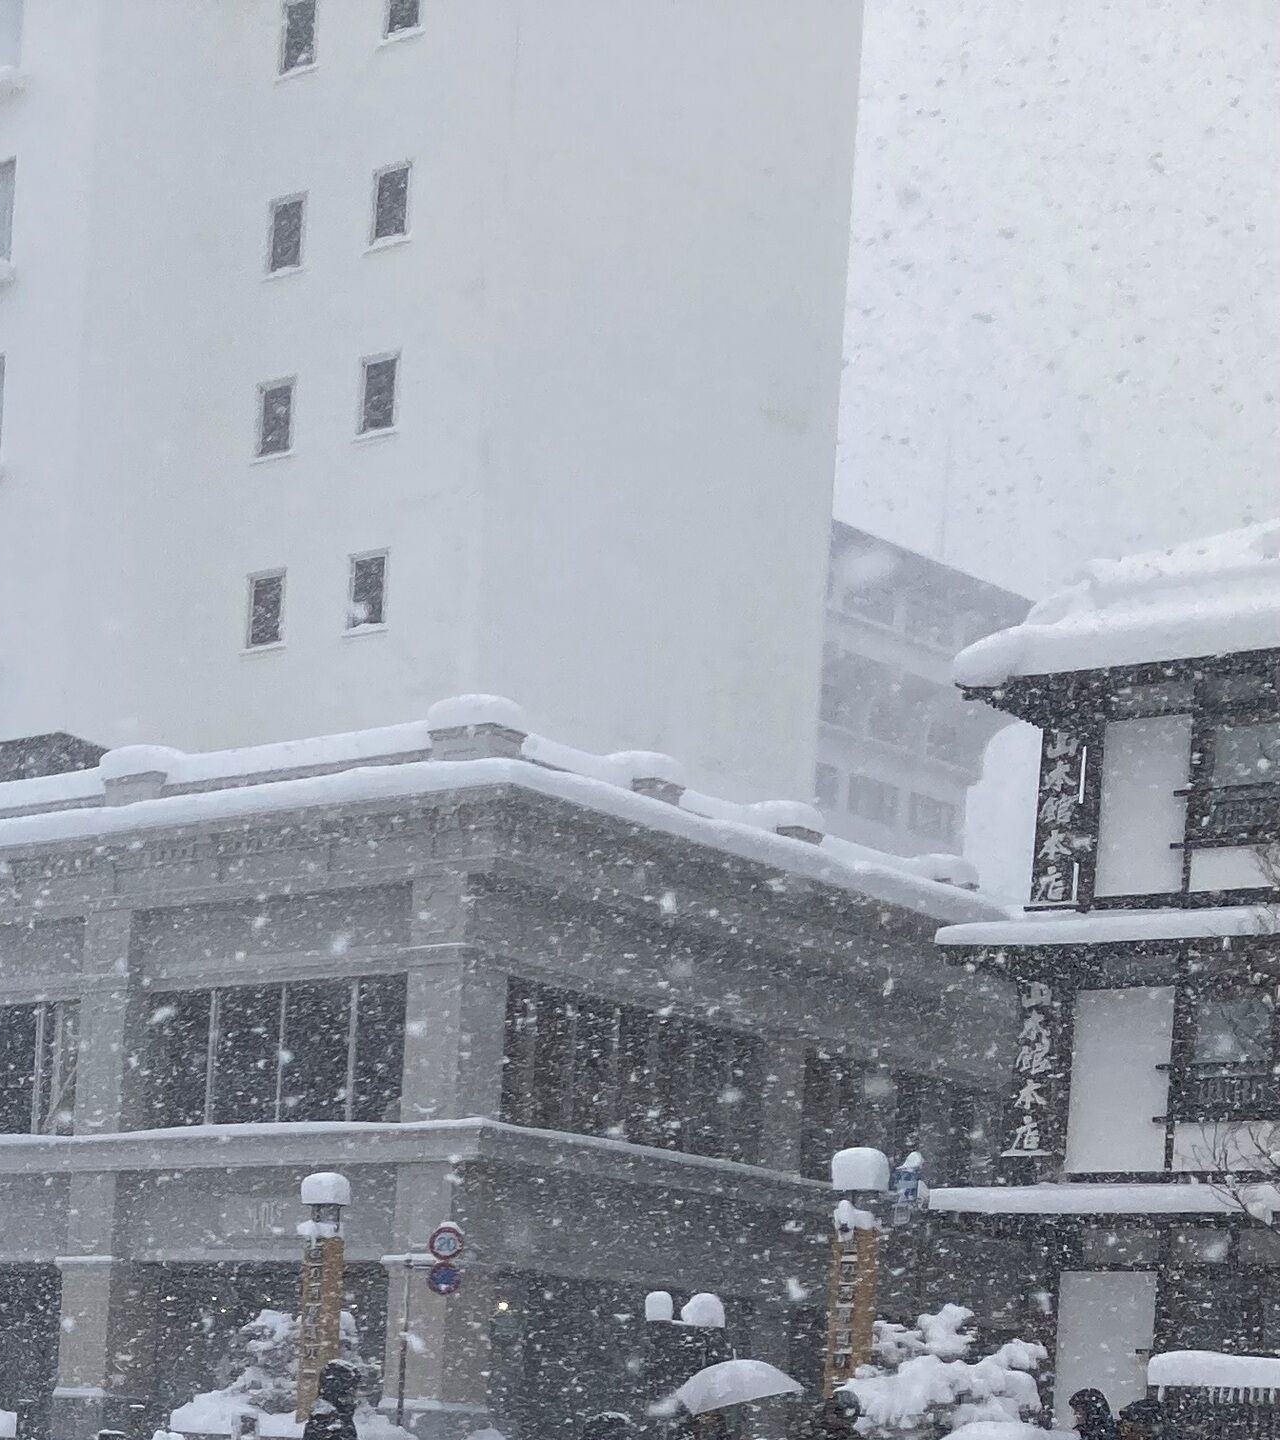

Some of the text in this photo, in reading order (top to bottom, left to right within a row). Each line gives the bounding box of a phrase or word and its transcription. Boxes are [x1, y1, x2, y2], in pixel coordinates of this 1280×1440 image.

[1037, 730, 1080, 901] 山本館本店
[1011, 981, 1053, 1150] 山本館本店
[437, 1236, 457, 1251] 20
